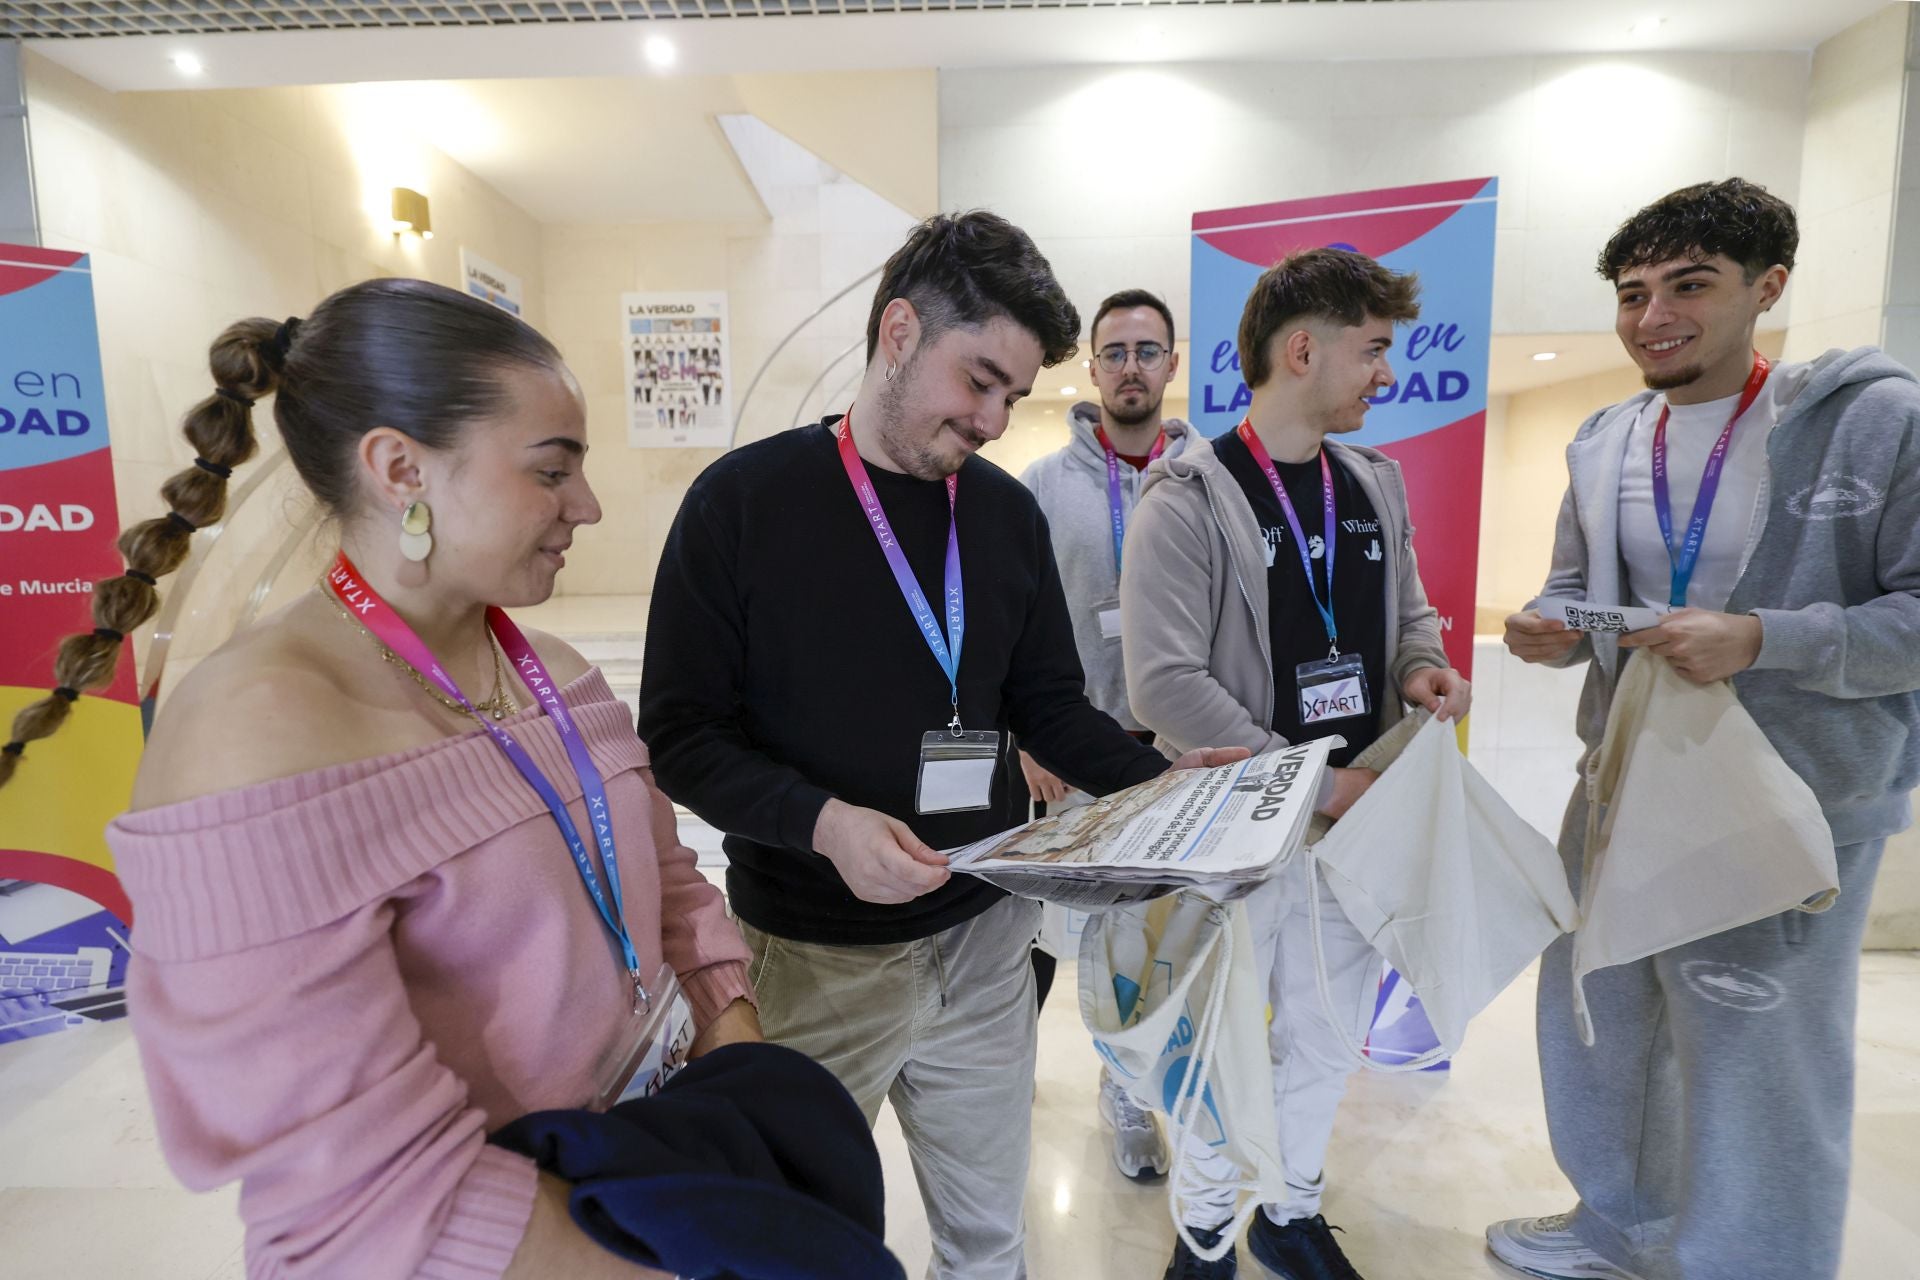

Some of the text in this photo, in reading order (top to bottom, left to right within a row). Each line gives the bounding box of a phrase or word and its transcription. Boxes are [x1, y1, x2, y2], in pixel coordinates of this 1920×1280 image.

[629, 304, 695, 315] LA VERDAD
[1404, 322, 1466, 361] en
[14, 370, 81, 399] en
[1204, 382, 1253, 413] LA
[1655, 446, 1664, 478] XTART
[1266, 467, 1286, 498] XTART
[1324, 481, 1333, 513] XTART
[0, 503, 94, 532] DAD
[868, 506, 895, 548] XTART
[1685, 517, 1705, 554] XTART
[20, 577, 93, 595] Murcia
[331, 565, 377, 615] XTART
[949, 587, 961, 632] XTART
[919, 614, 946, 657] XTART
[516, 653, 559, 705] XTART
[1303, 694, 1359, 719] XTART
[1250, 748, 1309, 821] VERDAD
[1173, 789, 1204, 820] directivos
[591, 796, 614, 860] XTART
